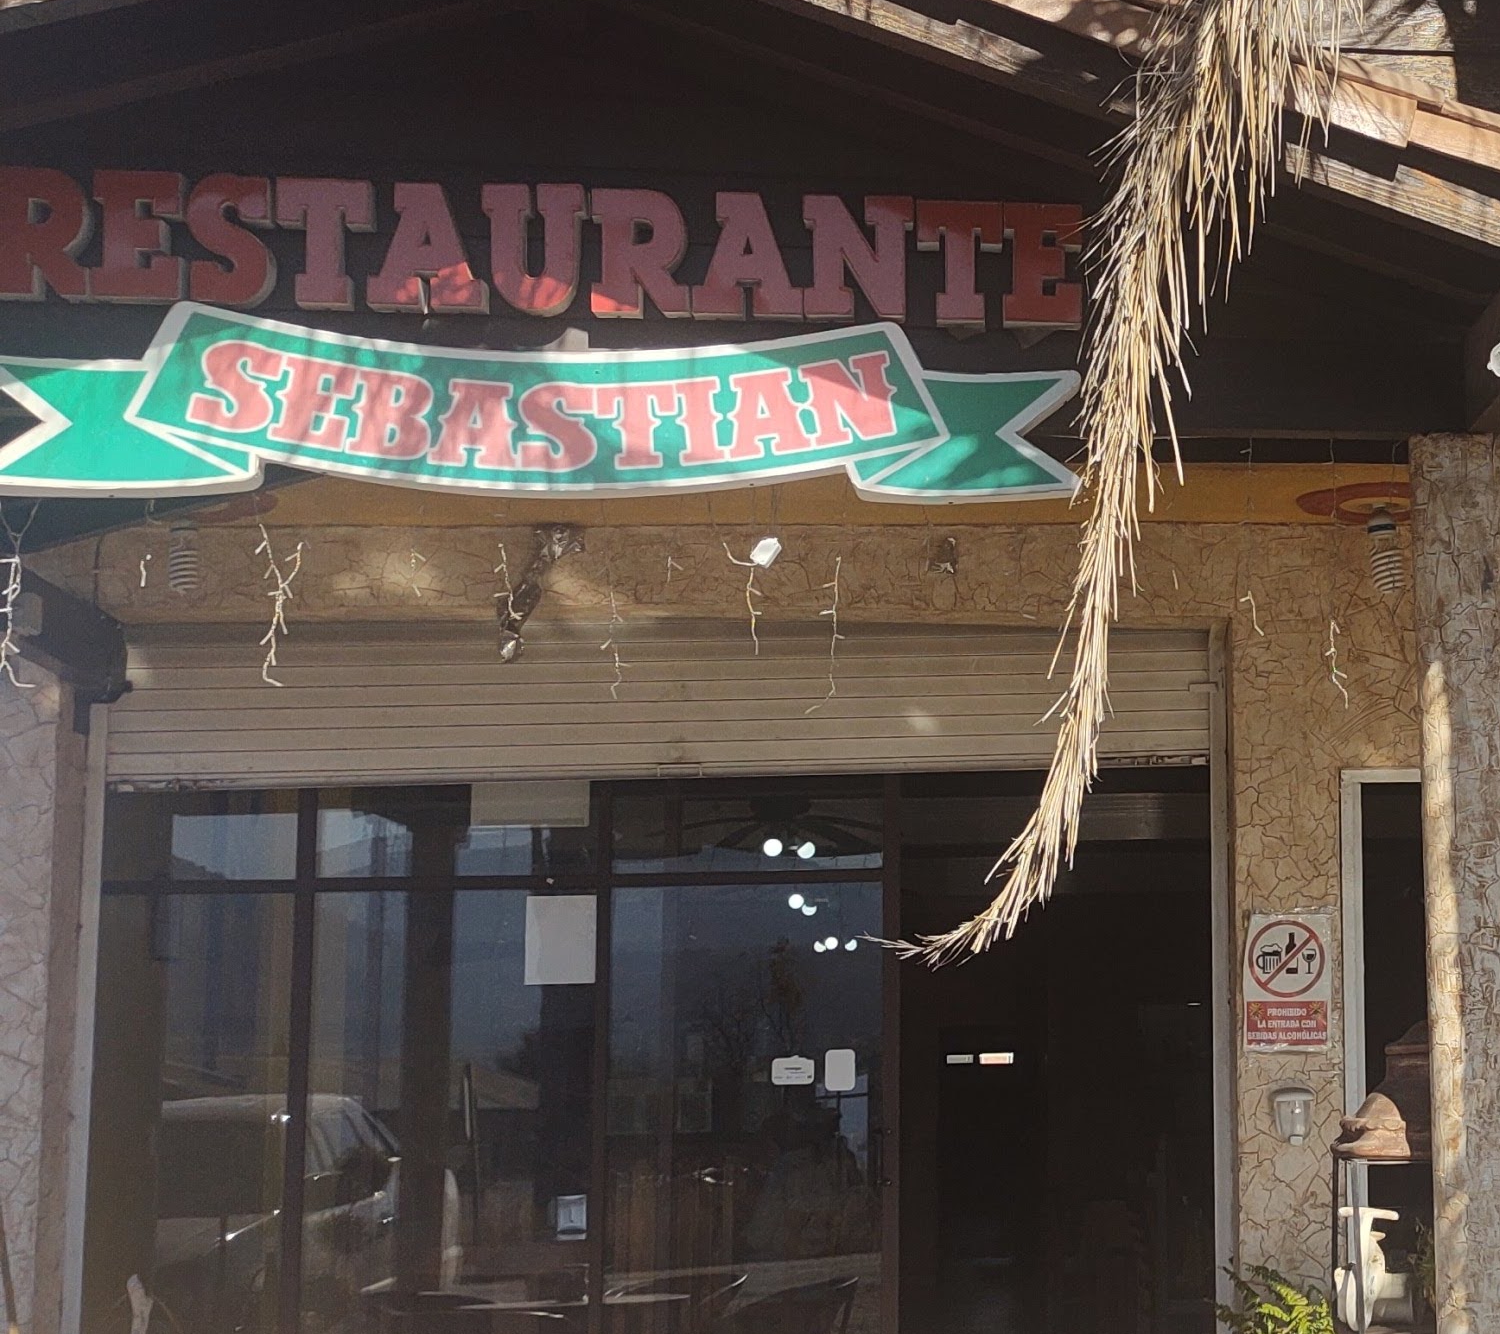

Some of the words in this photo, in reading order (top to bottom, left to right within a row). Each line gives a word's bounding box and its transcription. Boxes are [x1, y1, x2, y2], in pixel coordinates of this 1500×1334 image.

[0, 167, 1082, 329] RESTAURANTE
[186, 340, 897, 472] SEBASTIAN
[1267, 1008, 1307, 1016] PROHIBIDO
[1257, 1019, 1267, 1028] LA
[1268, 1019, 1300, 1028] ENTRADA
[1301, 1019, 1317, 1028] CON
[1248, 1031, 1277, 1040] BEBIDAS
[1279, 1029, 1327, 1040] ALCOHÓLICAS
